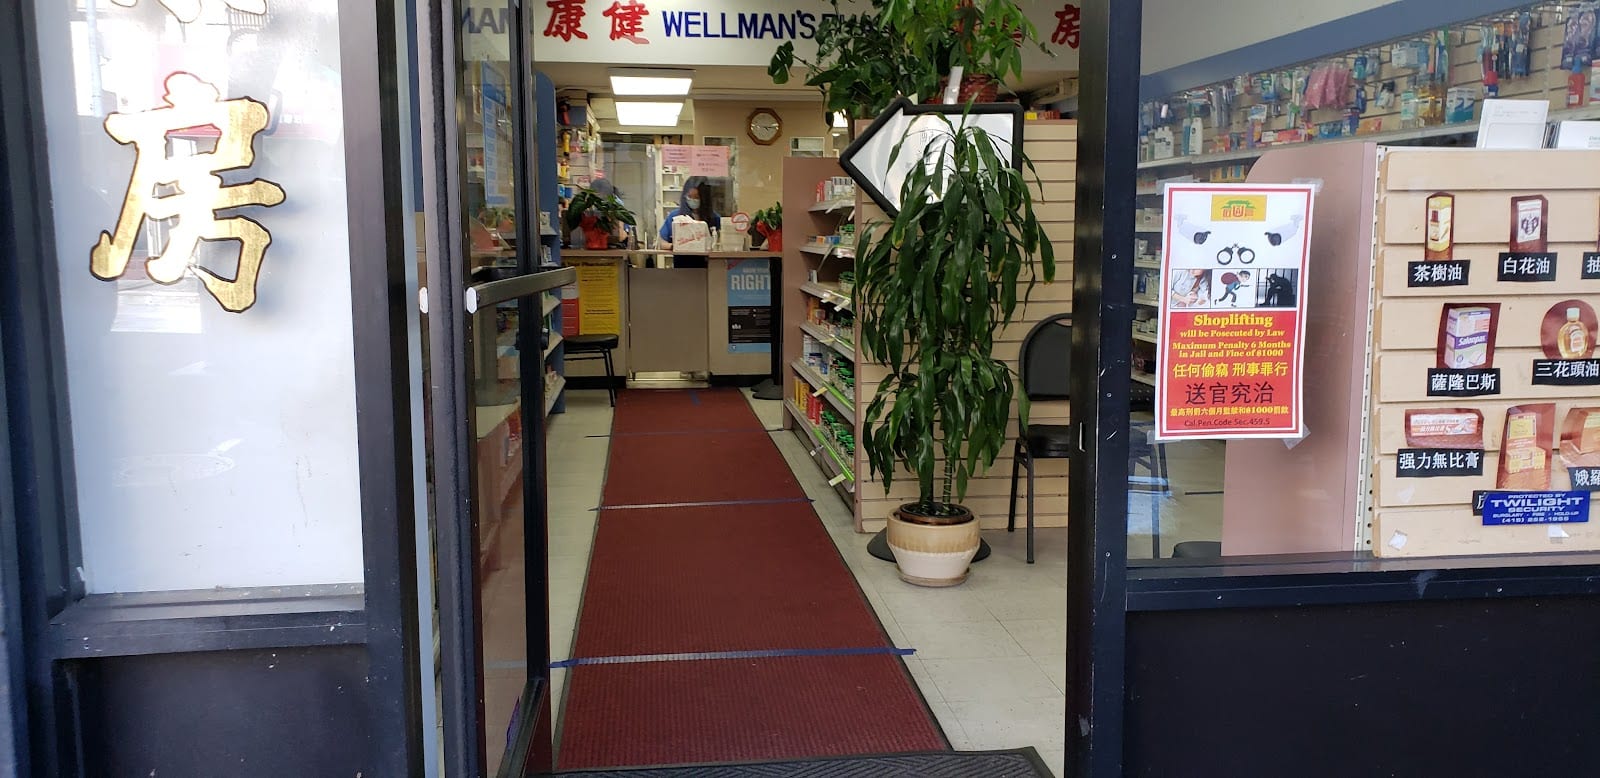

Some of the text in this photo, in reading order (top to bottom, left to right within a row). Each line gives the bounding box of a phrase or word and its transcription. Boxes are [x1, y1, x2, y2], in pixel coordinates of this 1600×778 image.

[662, 10, 816, 39] WELLMAN'S
[90, 71, 287, 312] 房
[1413, 264, 1462, 283] 茶樹油
[1503, 257, 1550, 275] 白花油
[1193, 313, 1273, 328] Shoplifting
[1180, 328, 1285, 338] will be Posecuted by Law
[1173, 340, 1291, 350] Maximum Penalty 6 Months
[1179, 350, 1188, 358] in
[1190, 350, 1206, 358] Jail
[1208, 350, 1223, 358] and
[1226, 350, 1245, 358] Fine
[1246, 349, 1257, 357] of
[1173, 361, 1289, 379] 任何偷竊 刑事罪行
[1535, 361, 1600, 378] 三花頭油
[1431, 373, 1496, 391] 薩隆巴斯
[1185, 381, 1275, 405] 送官究治
[1490, 497, 1584, 508] TWILIGHT
